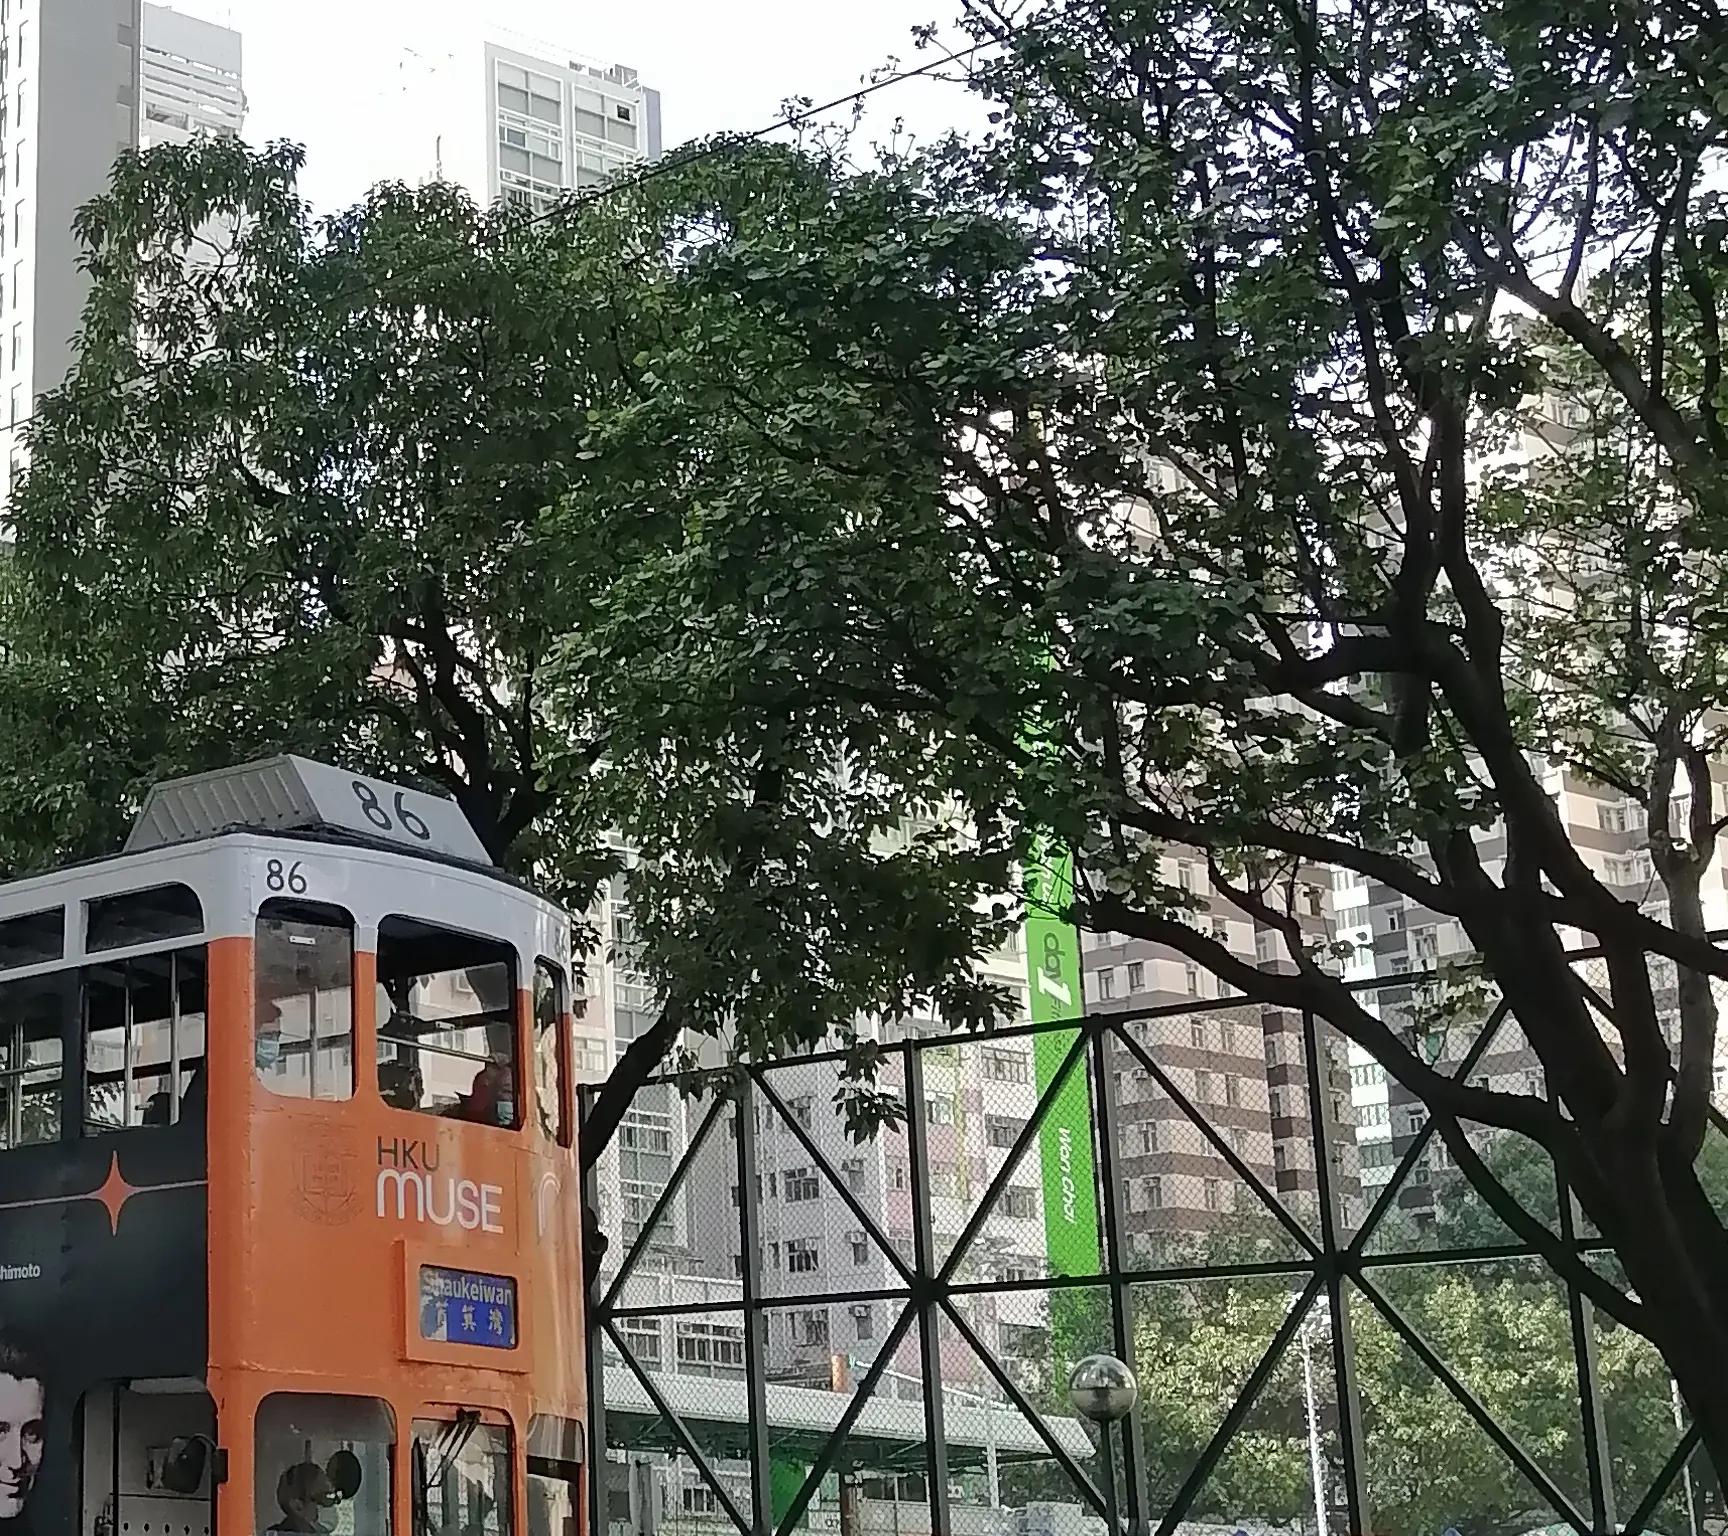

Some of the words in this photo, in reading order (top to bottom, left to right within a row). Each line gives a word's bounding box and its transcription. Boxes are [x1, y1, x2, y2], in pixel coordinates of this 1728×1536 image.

[351, 779, 432, 841] 86
[265, 858, 308, 895] 86
[376, 1135, 440, 1172] HKU
